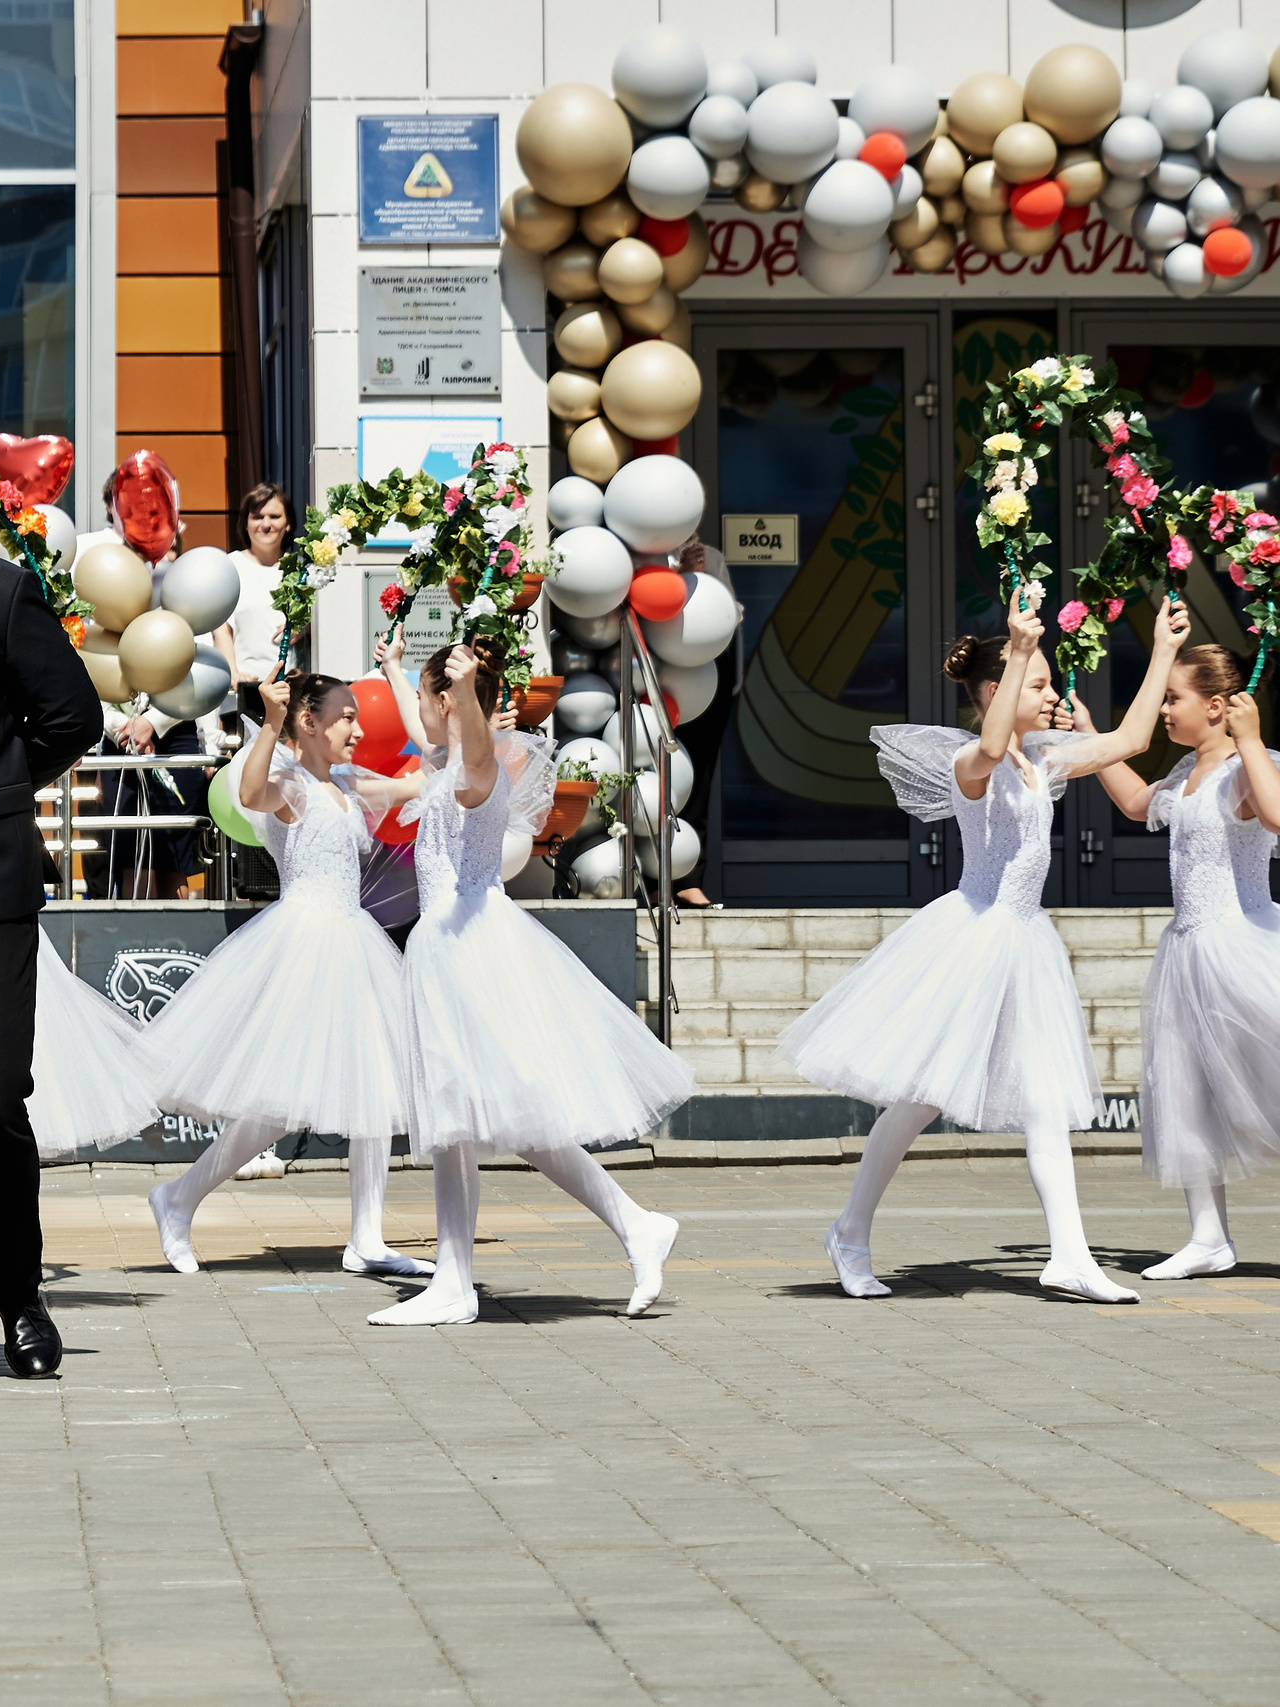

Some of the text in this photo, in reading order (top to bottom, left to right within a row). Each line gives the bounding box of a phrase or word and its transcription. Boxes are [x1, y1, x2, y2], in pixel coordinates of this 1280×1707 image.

[371, 277, 404, 285] ЗДАНИЕ
[392, 286, 421, 294] ЛИЦЕЯ
[441, 376, 491, 384] ГАЗПРОМБАНК
[738, 534, 782, 549] ВХОД
